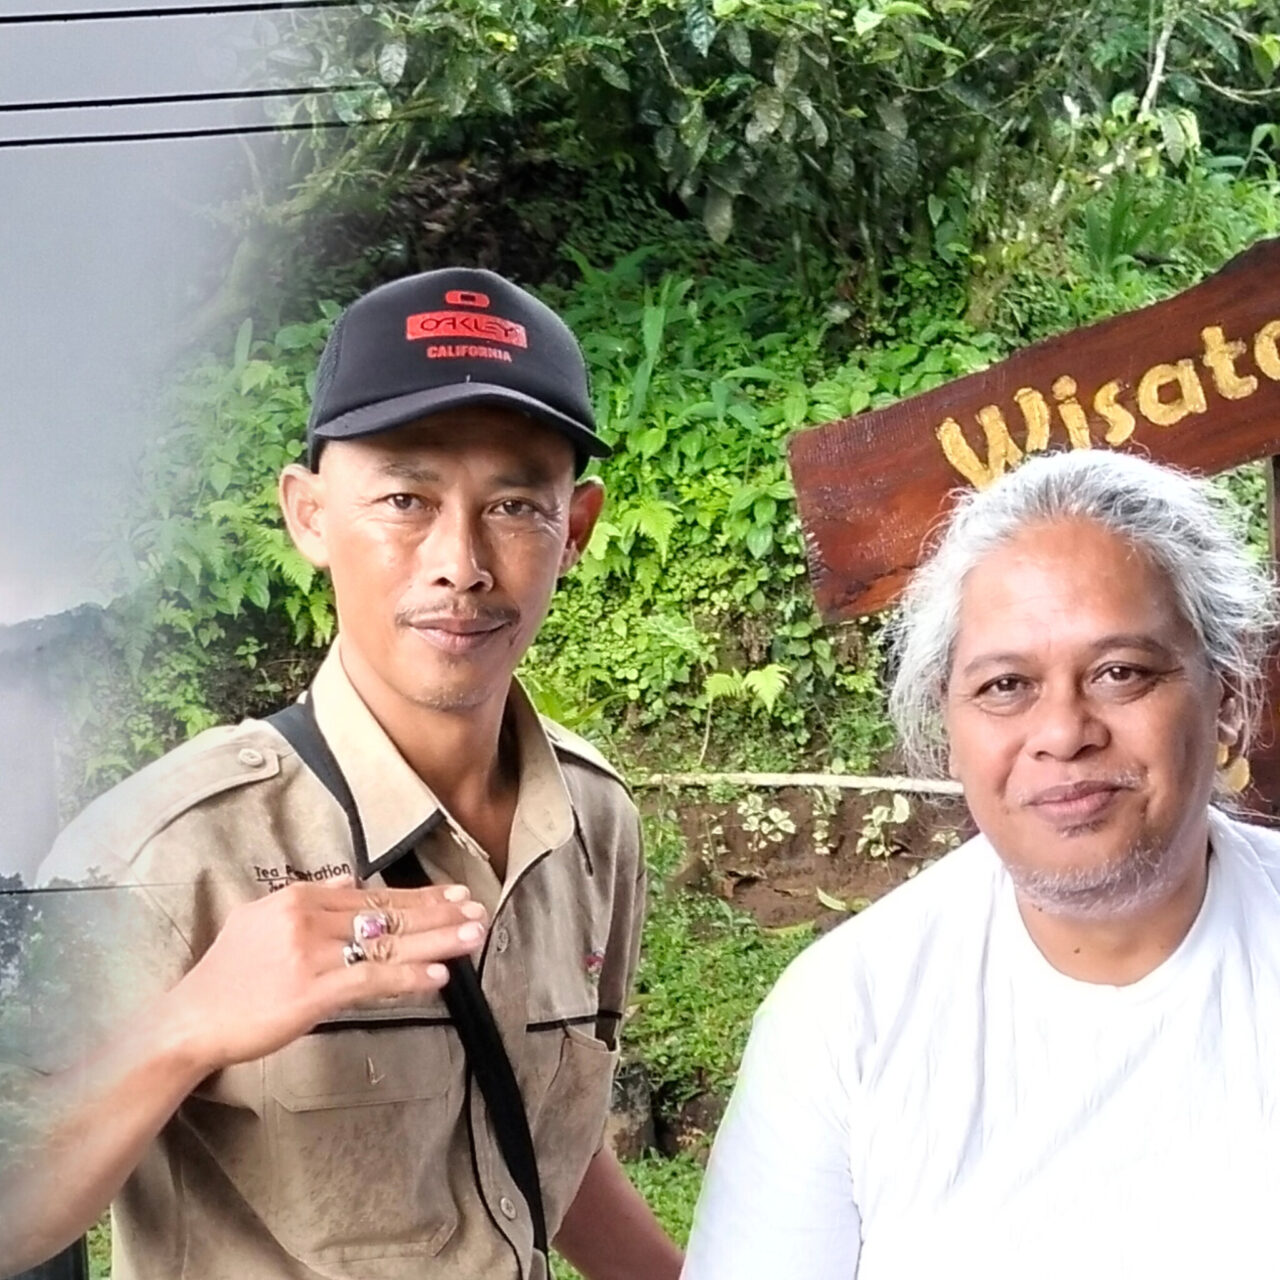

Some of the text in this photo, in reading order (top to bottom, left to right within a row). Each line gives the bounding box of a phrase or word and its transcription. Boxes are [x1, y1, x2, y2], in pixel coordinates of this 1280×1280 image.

[420, 317, 514, 337] OAKLEY
[427, 345, 512, 363] CALIFORNIA
[254, 865, 279, 878] Tea
